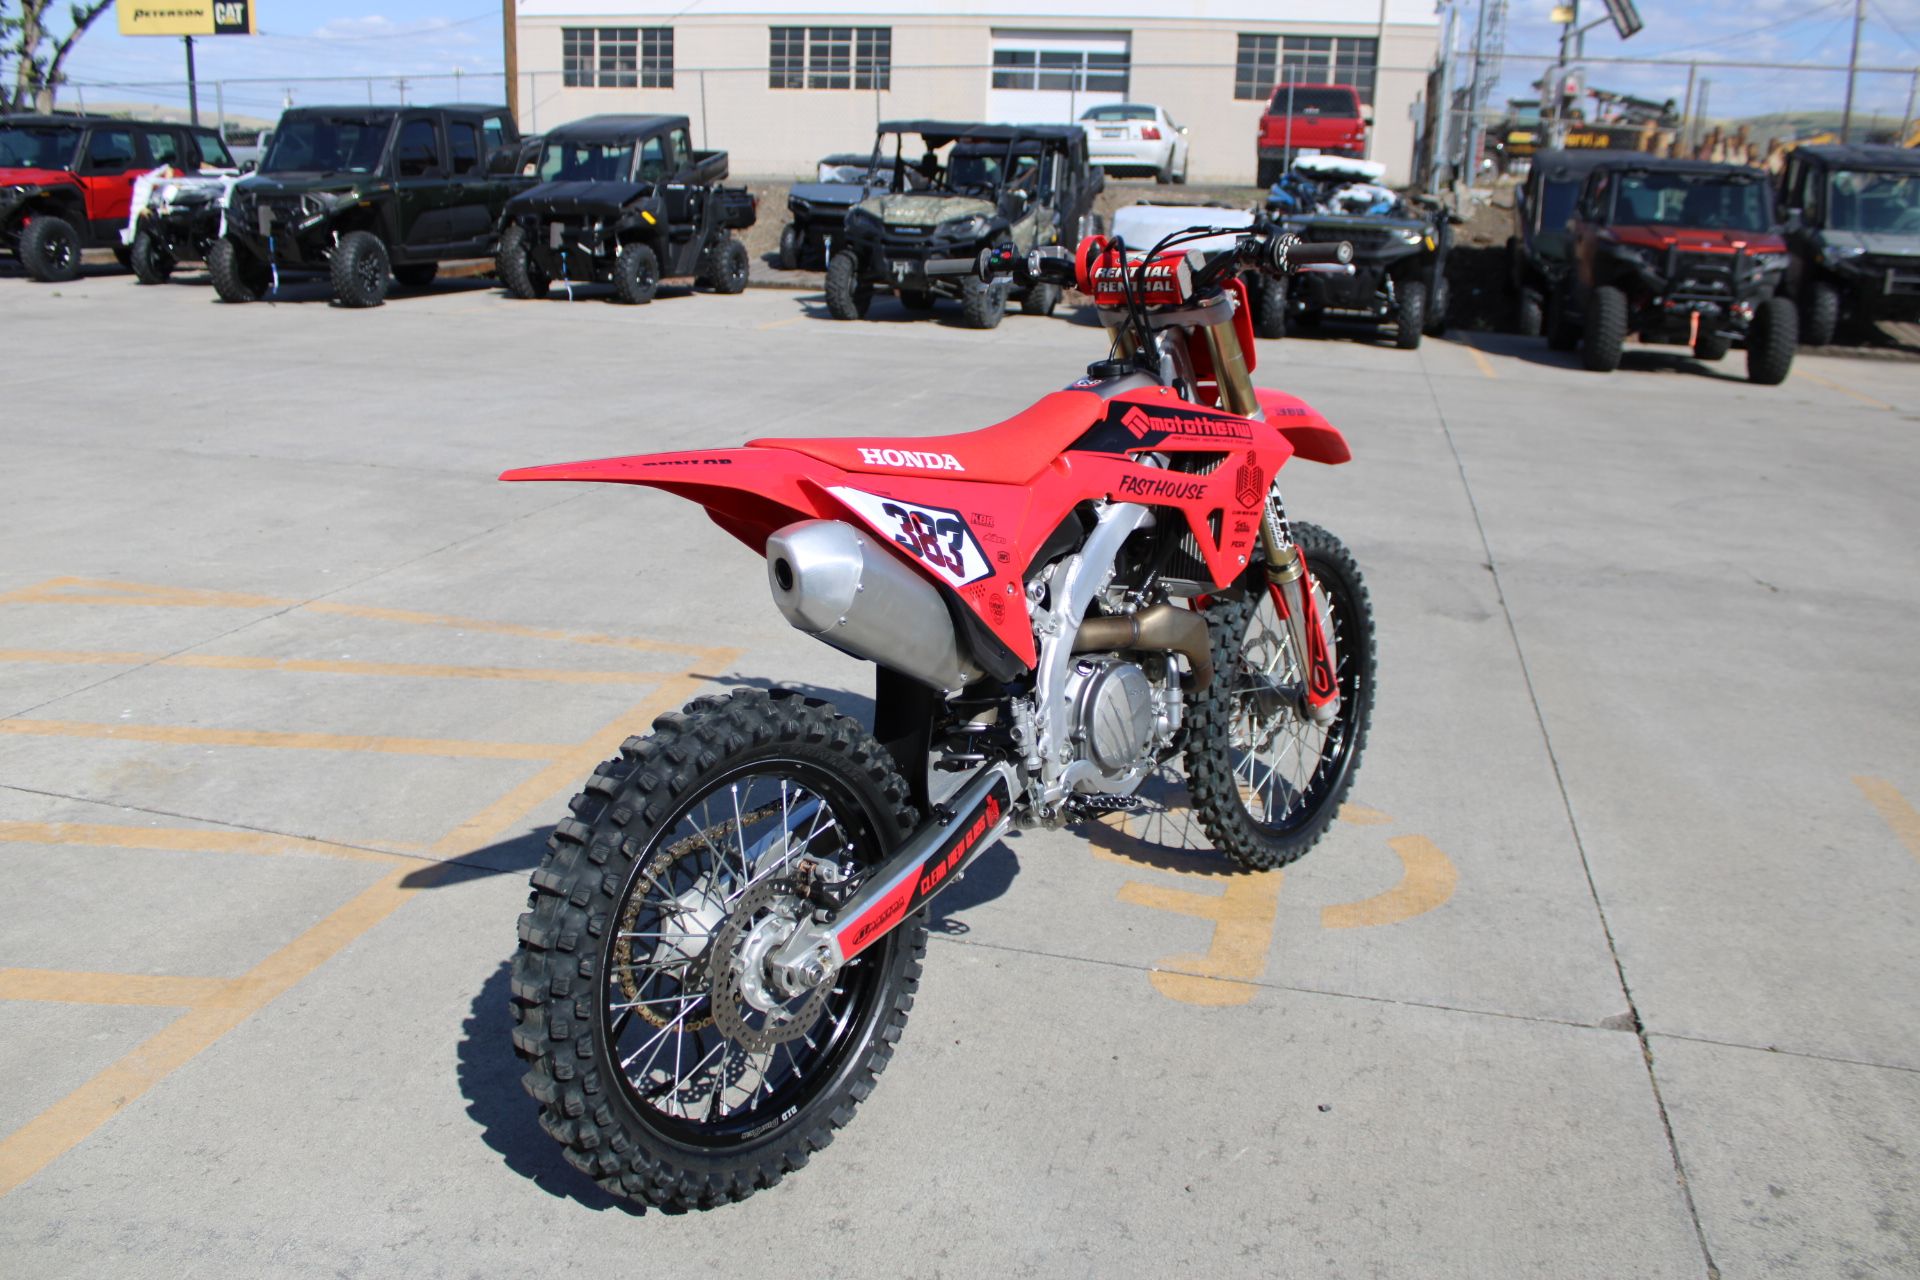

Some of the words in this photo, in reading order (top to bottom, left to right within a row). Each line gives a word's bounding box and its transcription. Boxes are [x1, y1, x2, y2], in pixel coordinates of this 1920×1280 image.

[214, 2, 243, 25] CAT
[857, 447, 966, 472] HONDA
[1118, 474, 1209, 500] FASTHOUSE
[881, 502, 966, 578] 383
